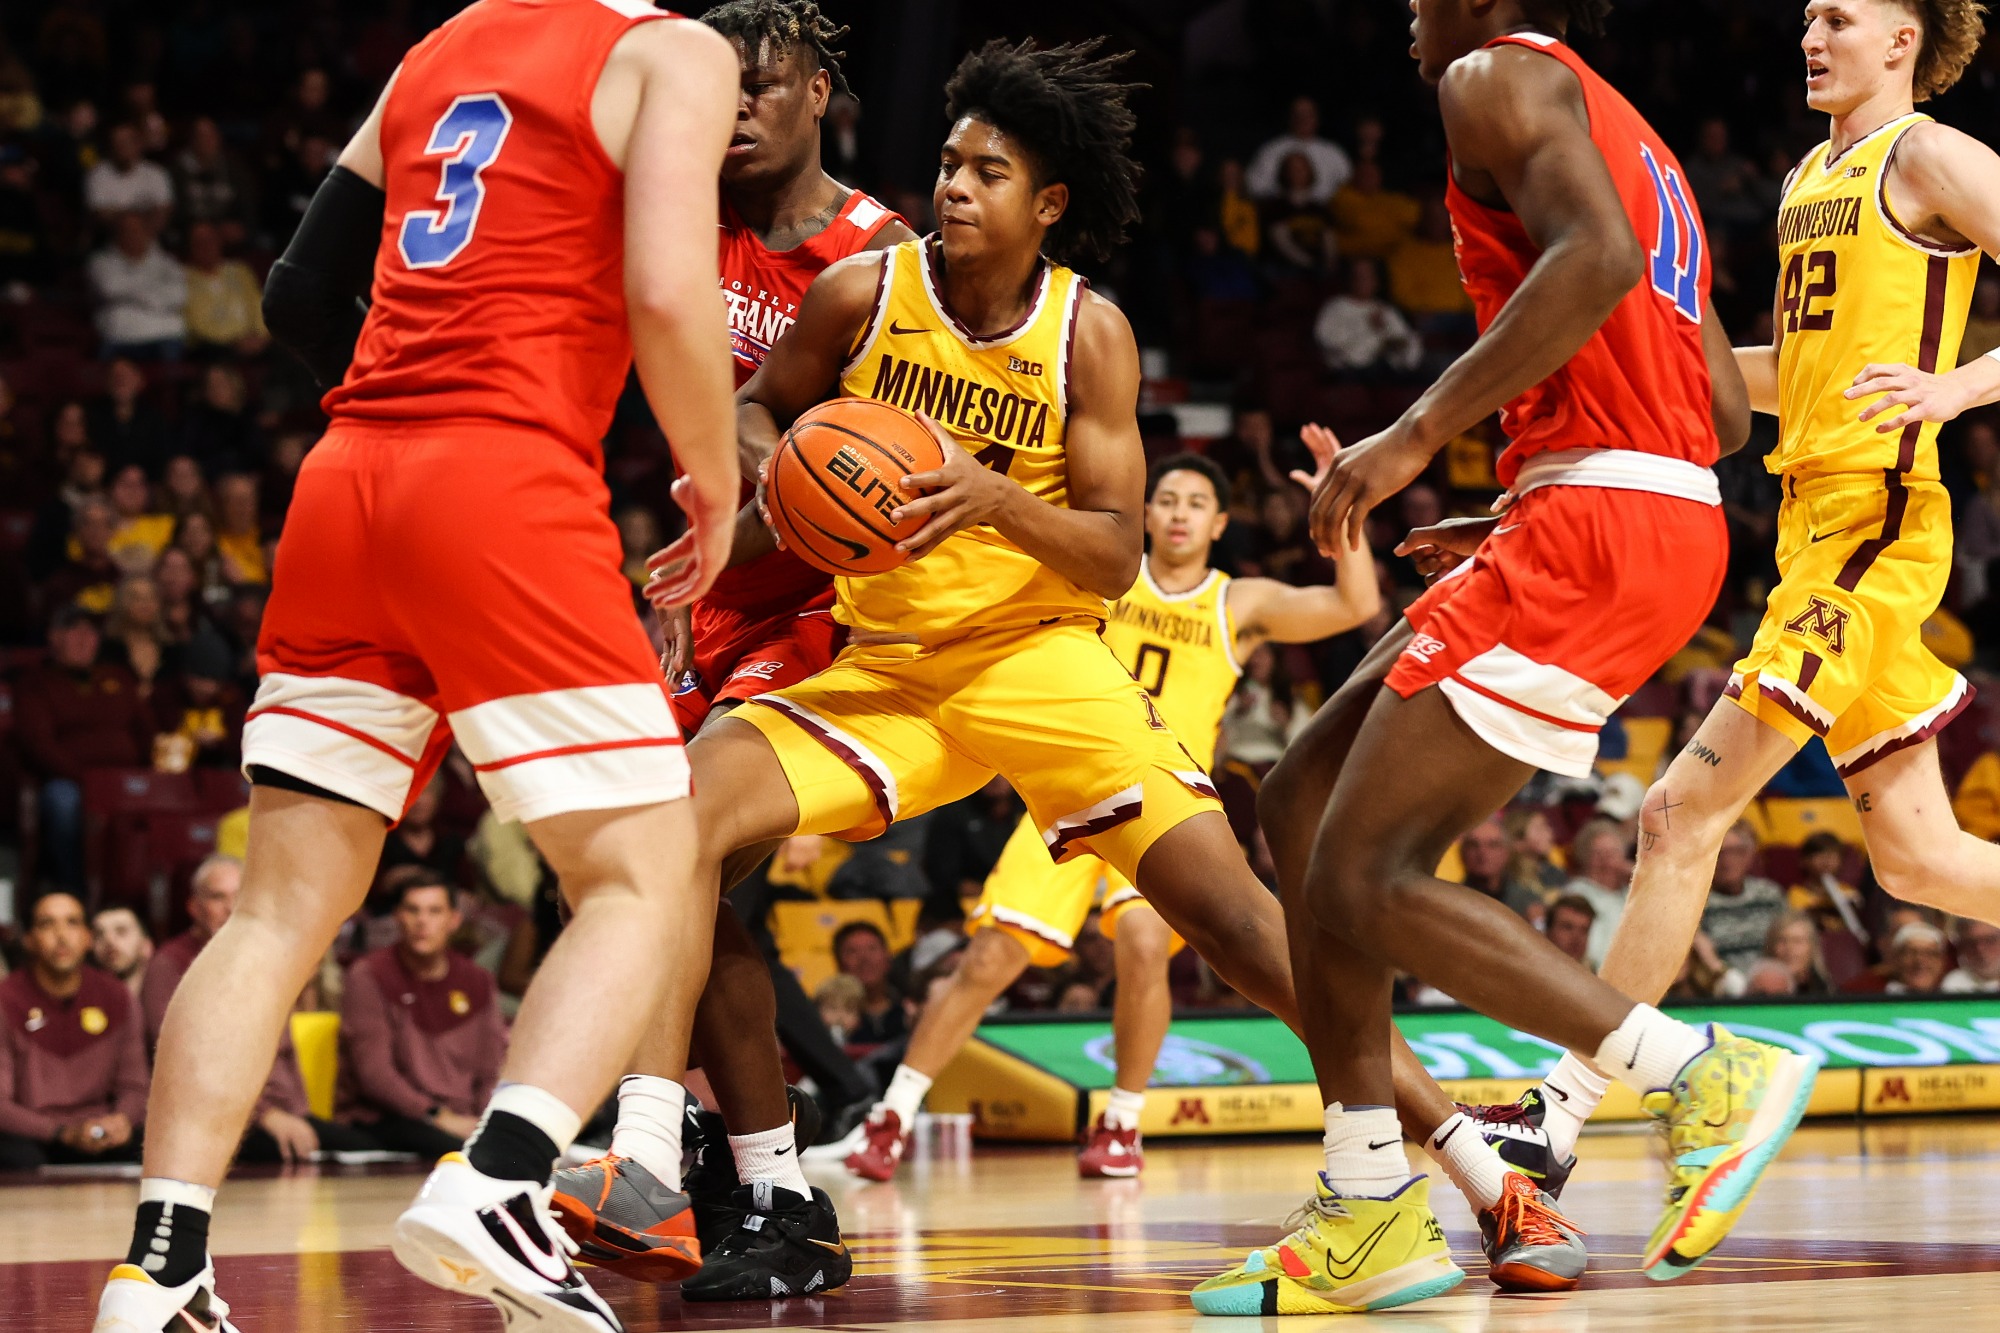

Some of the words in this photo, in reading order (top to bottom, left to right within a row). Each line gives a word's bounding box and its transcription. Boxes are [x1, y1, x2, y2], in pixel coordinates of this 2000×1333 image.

[397, 91, 514, 271] 3
[1639, 141, 1703, 325] 11
[1777, 196, 1863, 247] MINNESOTA
[1782, 250, 1837, 333] 42
[871, 353, 1049, 449] MINNESOTA
[825, 450, 905, 527] ELITE
[1113, 600, 1213, 648] MINNESOTA
[1783, 594, 1852, 658] M
[1134, 642, 1171, 698] 0
